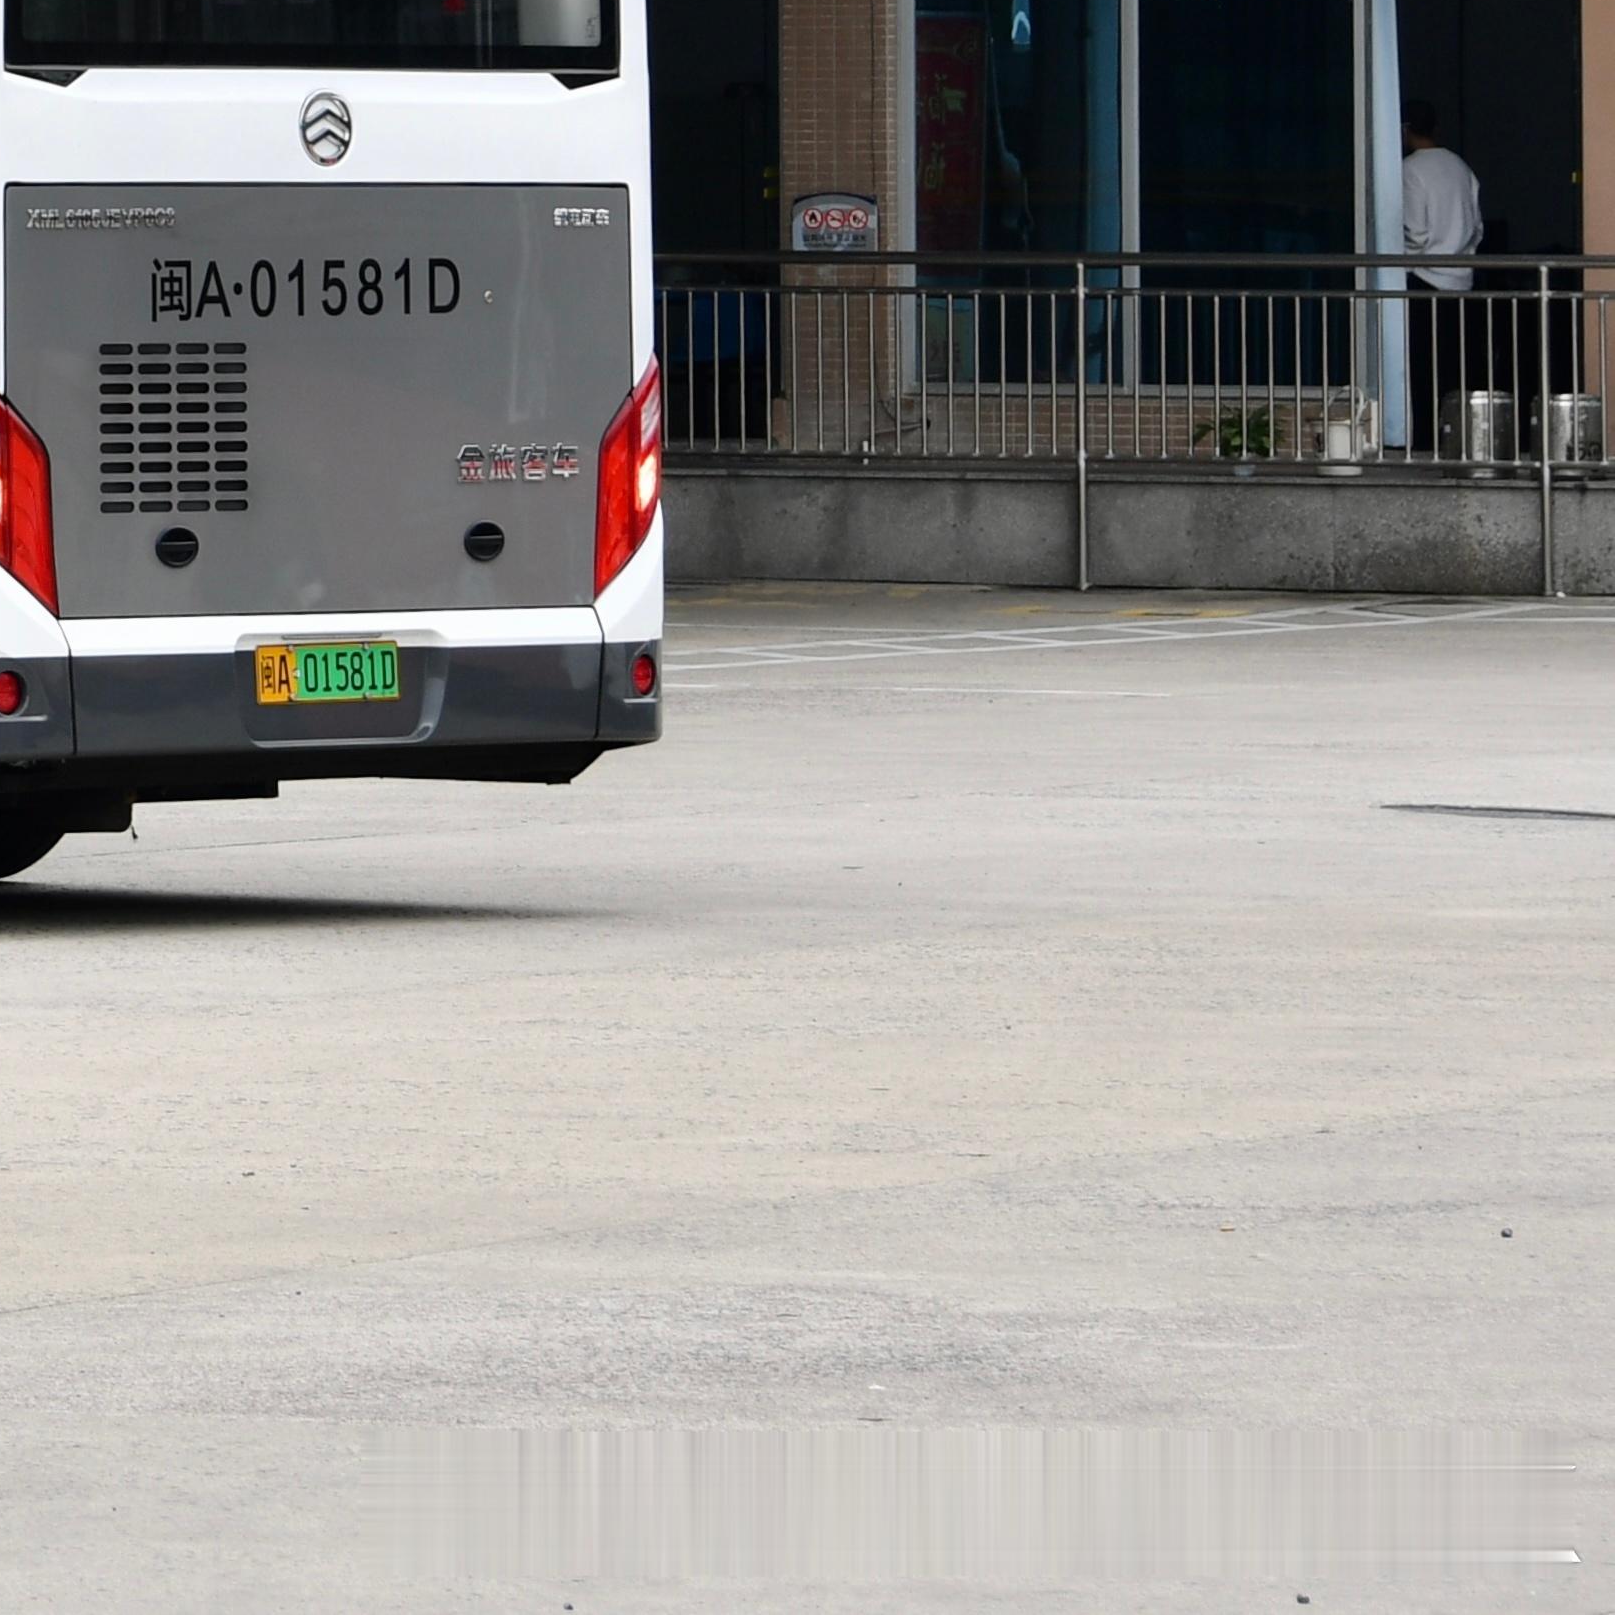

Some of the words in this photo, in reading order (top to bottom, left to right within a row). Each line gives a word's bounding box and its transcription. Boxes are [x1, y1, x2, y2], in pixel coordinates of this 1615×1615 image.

[151, 257, 461, 323] 闽A·01581D
[456, 442, 580, 483] 金旅客车
